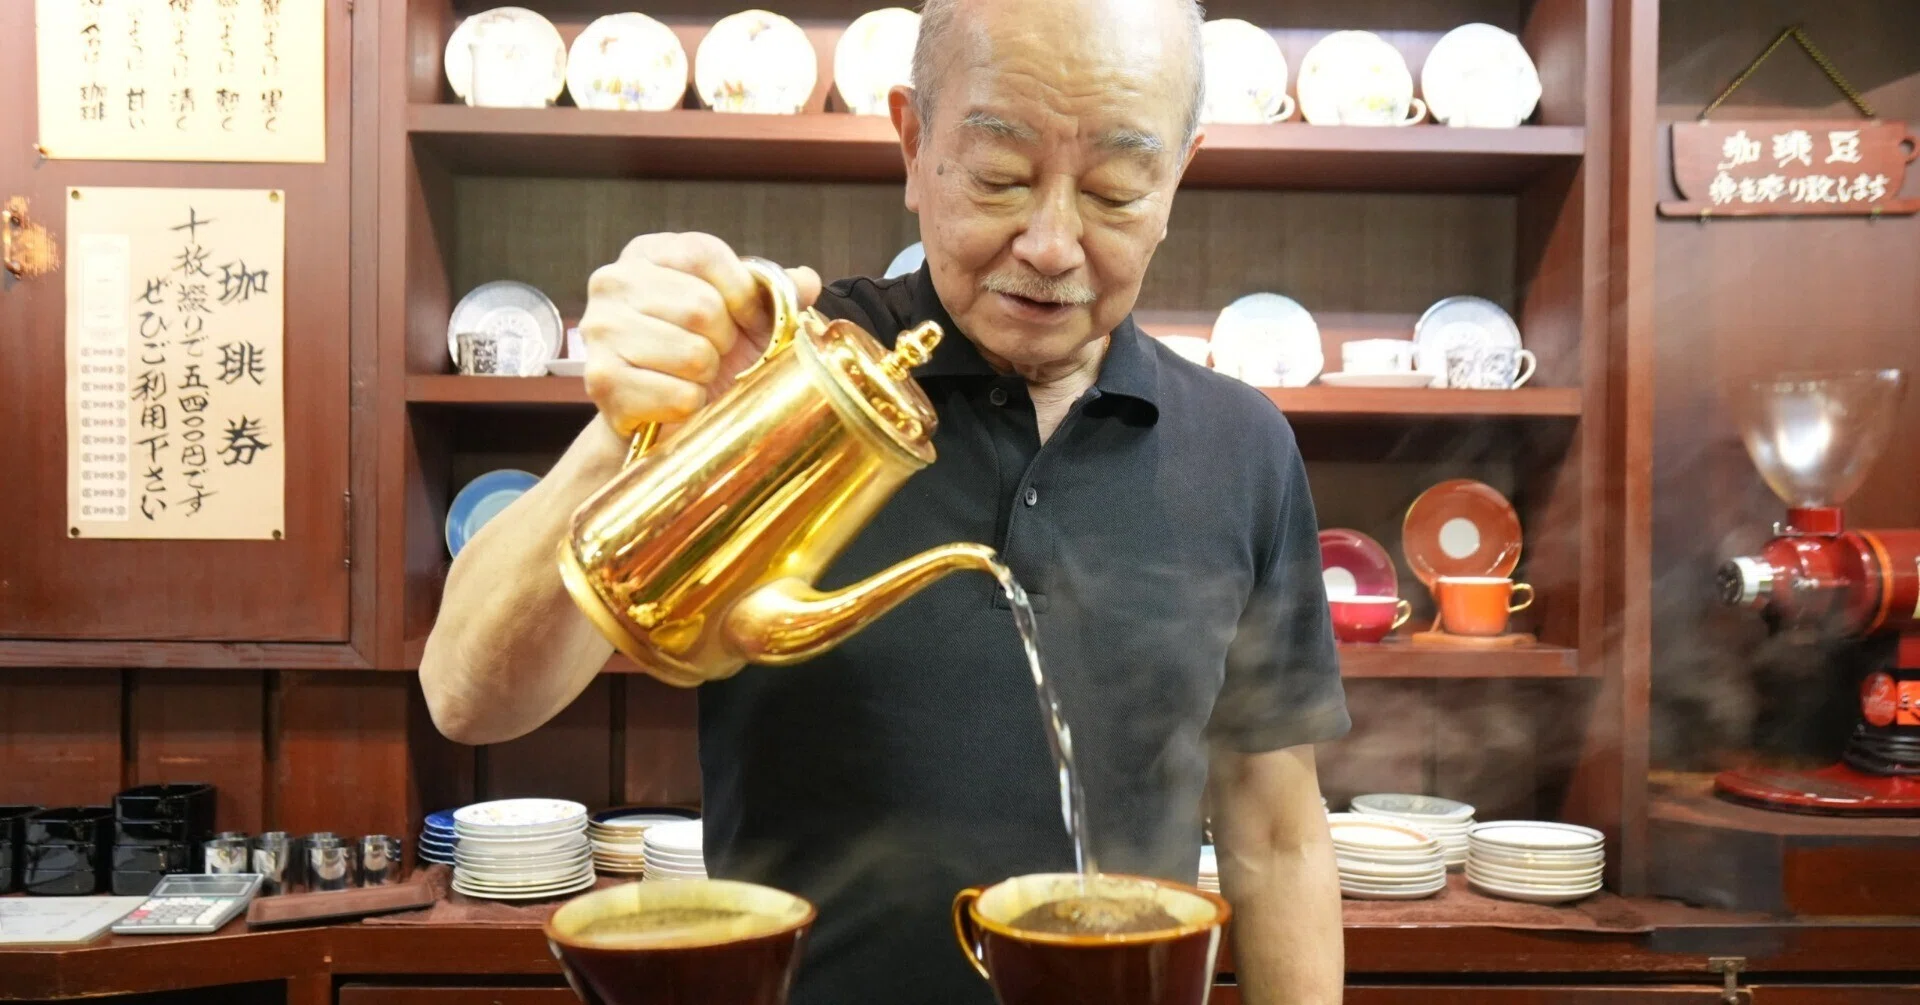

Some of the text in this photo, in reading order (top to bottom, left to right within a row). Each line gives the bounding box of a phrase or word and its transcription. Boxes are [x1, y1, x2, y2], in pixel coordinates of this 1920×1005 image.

[1717, 130, 1861, 170] 珈琲豆
[132, 276, 172, 521] ぜひご利用下さい
[217, 259, 272, 466] 珈琲券
